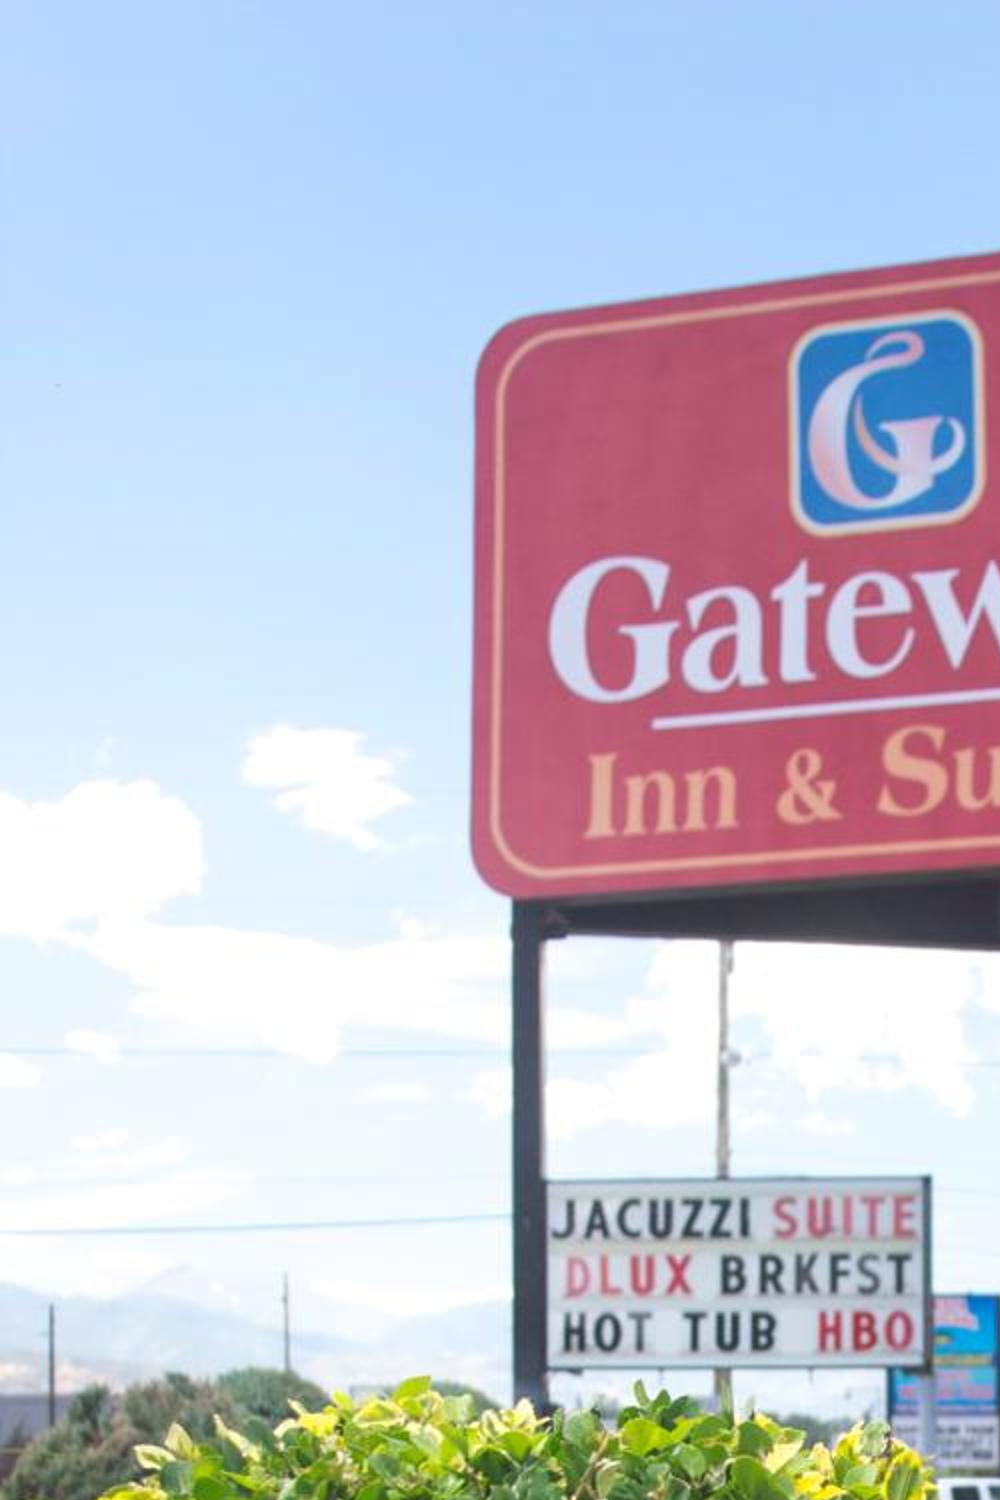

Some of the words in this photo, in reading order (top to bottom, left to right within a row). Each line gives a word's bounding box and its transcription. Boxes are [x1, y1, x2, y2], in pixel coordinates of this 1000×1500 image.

[584, 752, 738, 841] Inn
[775, 749, 841, 825] &
[552, 1199, 751, 1239] JACUZZI
[773, 1196, 915, 1239] SUITE
[565, 1255, 693, 1296] DLUX
[720, 1253, 913, 1295] BRKFST
[564, 1312, 651, 1353] HOT
[682, 1311, 777, 1352] TUB
[817, 1311, 914, 1352] HBO
